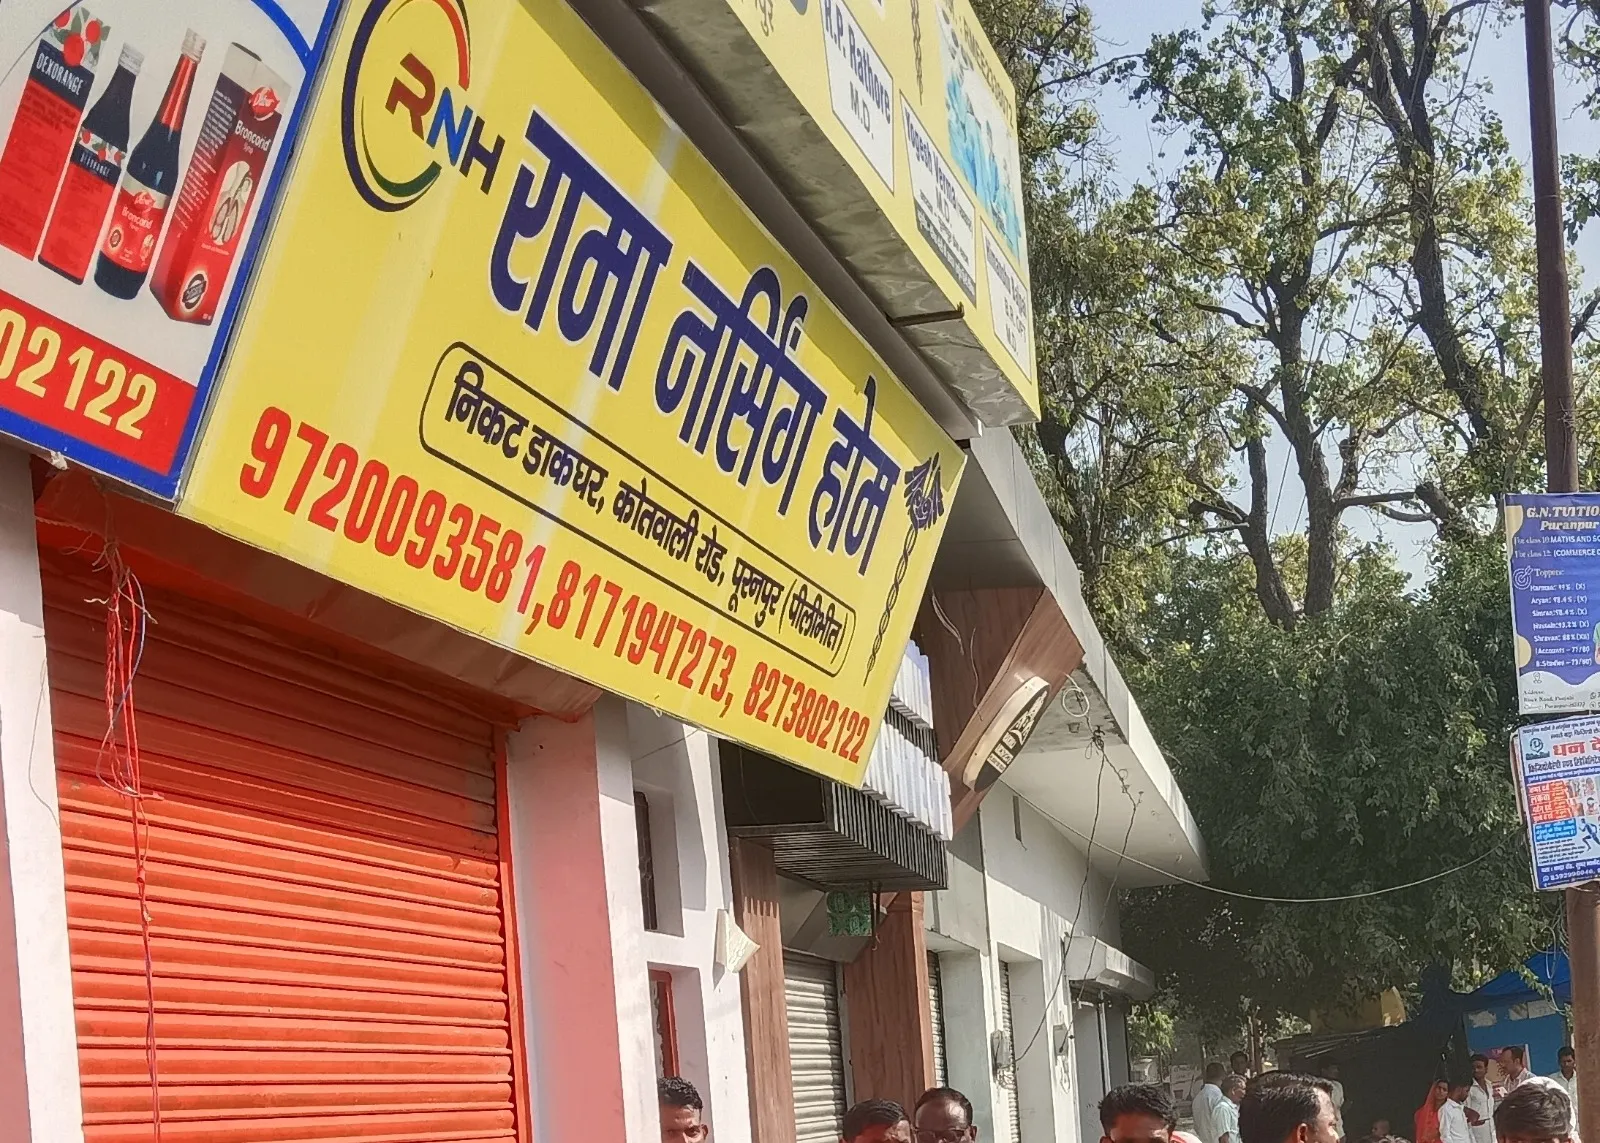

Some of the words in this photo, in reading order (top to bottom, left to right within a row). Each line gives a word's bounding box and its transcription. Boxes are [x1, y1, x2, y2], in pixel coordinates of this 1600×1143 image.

[385, 52, 505, 195] RNH
[849, 24, 891, 124] Rathore
[850, 82, 874, 139] M.D.
[489, 108, 673, 391] रामा
[654, 266, 828, 517] नर्सिंग
[808, 375, 902, 576] होम
[445, 361, 529, 458] निकट
[522, 424, 609, 514] डाकघर,
[613, 476, 699, 563] कोतवाली
[695, 525, 728, 587] रोड,
[728, 557, 785, 628] पूरनपुर
[779, 579, 849, 664] (पीलीभीत)
[1540, 520, 1600, 532] Puranpur
[1551, 535, 1576, 543] MATHS
[1577, 535, 1592, 543] AND
[1553, 548, 1596, 557] (COMMERCE
[743, 661, 871, 764] 8273802122
